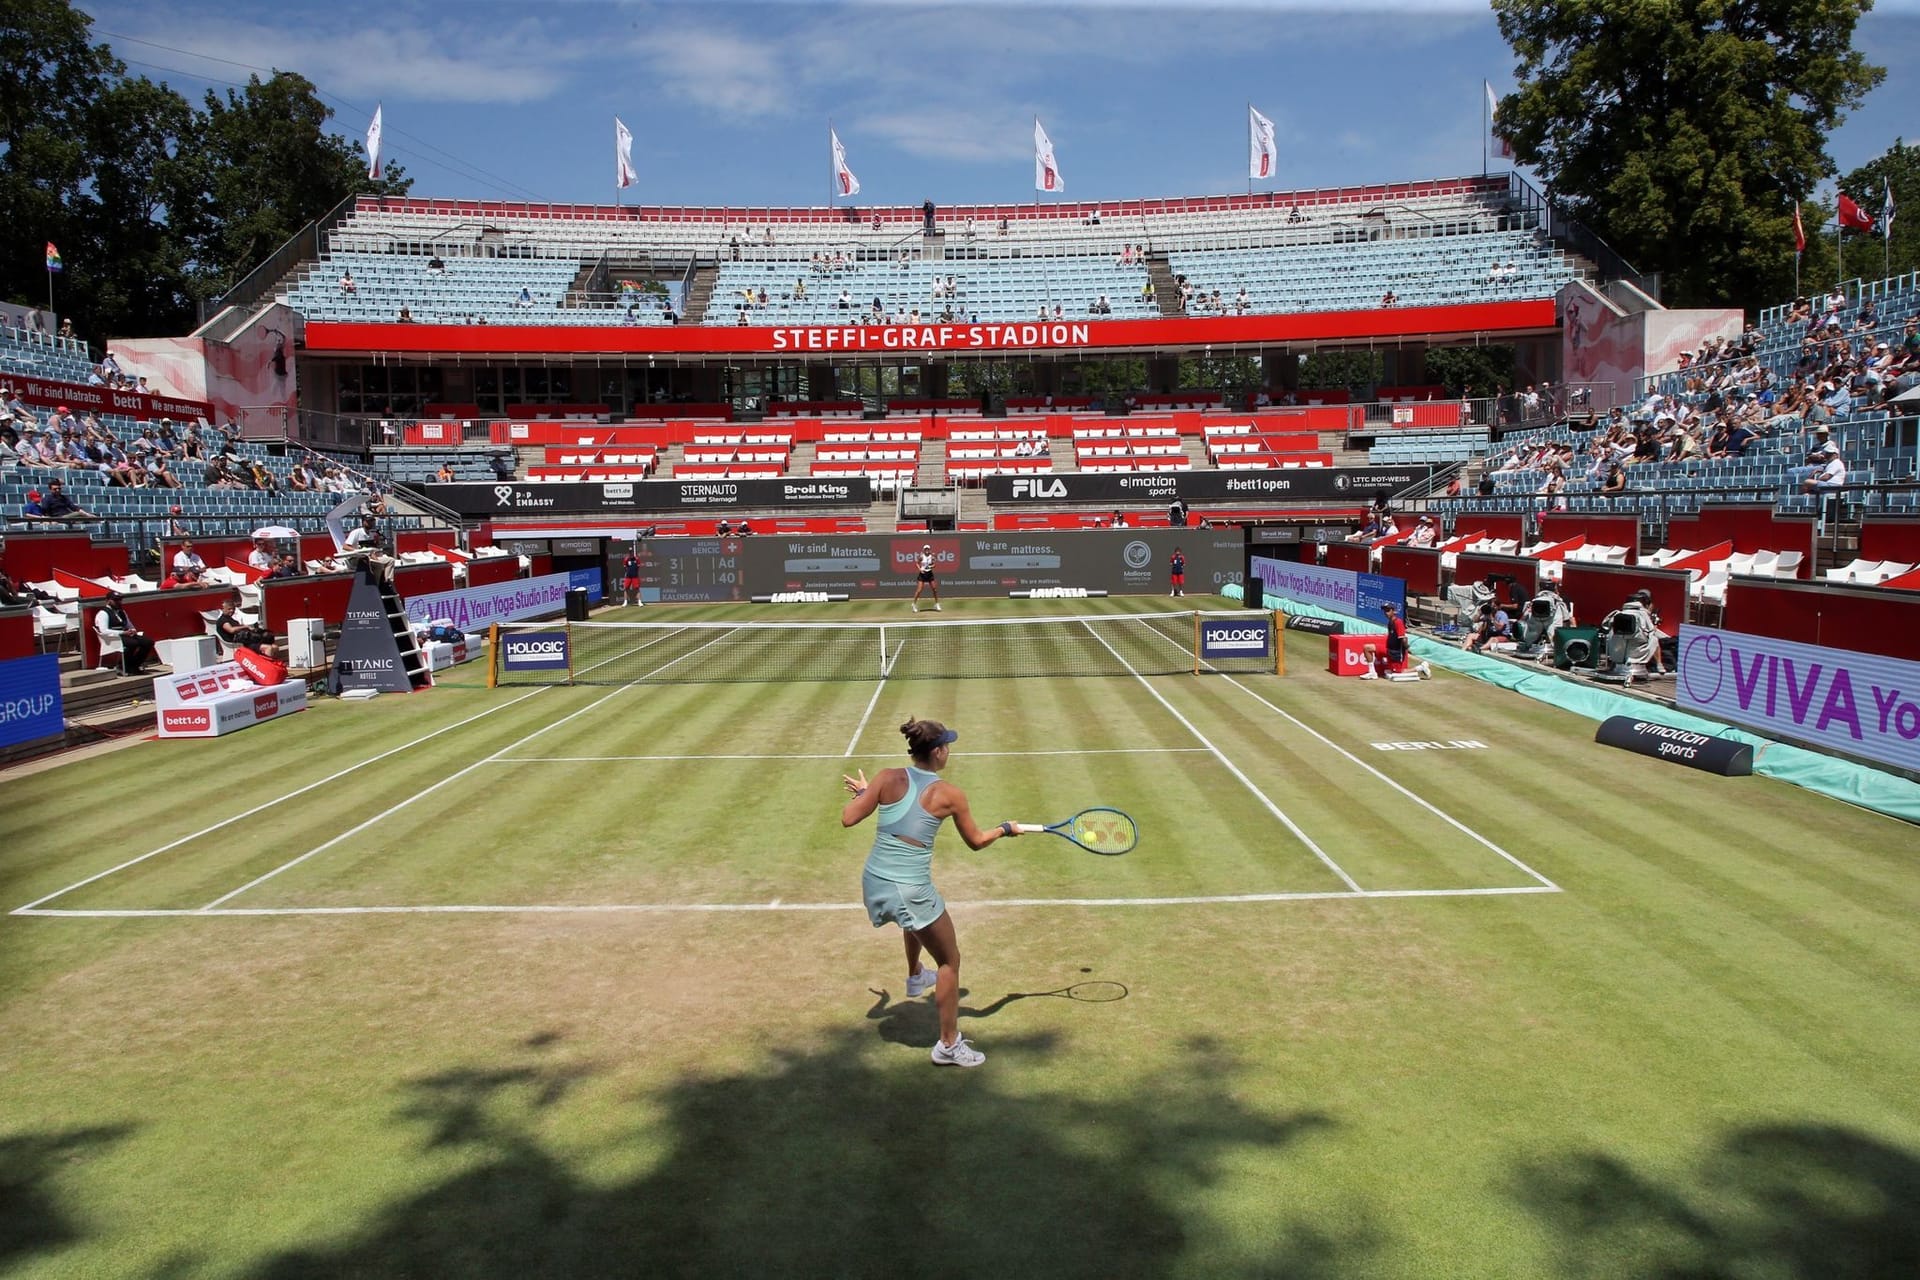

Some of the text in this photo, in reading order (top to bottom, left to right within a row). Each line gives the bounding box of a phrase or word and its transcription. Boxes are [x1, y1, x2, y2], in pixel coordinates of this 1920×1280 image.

[772, 324, 1090, 349] STEFFI-GRAF-STADION
[27, 382, 104, 405] Wir sind Matratze.
[113, 393, 142, 410] bett1
[151, 399, 206, 417] We are mattress.
[1226, 478, 1290, 491] #bett1open
[1370, 475, 1411, 483] ROT-WEISS
[681, 484, 738, 496] STERNAUTO
[784, 484, 816, 494] Broil
[1012, 478, 1068, 498] FILA
[1148, 487, 1177, 497] sports
[516, 498, 554, 507] EMBASSY
[788, 543, 876, 558] Wir sind Matratze.
[976, 541, 1054, 554] We are mattress.
[670, 557, 735, 569] 3 Ad
[671, 573, 735, 585] 3 40
[1213, 571, 1244, 584] 0:30
[1257, 562, 1278, 591] VIVA
[1277, 570, 1290, 587] Your
[1289, 572, 1304, 595] Yoga
[1304, 576, 1326, 598] Studio
[1325, 580, 1333, 599] in
[1333, 583, 1355, 605] Berlin
[663, 593, 710, 601] KALINSKAYA
[427, 597, 470, 628] VIVA
[470, 599, 491, 618] Your
[492, 595, 514, 617] Yoga
[515, 587, 541, 609] Studio
[541, 587, 550, 603] in
[347, 611, 380, 619] TITANIC
[1206, 629, 1265, 641] HOLOGIC
[507, 641, 564, 654] HOLOGIC
[242, 658, 266, 680] Wilson
[341, 658, 394, 670] TITANIC
[359, 672, 377, 680] HOTELS
[1730, 648, 1864, 741] VIVA
[0, 694, 54, 724] GROUP
[255, 700, 277, 712] bett1.de
[166, 716, 207, 726] bett1.de
[1370, 741, 1489, 752] BERLIN
[1657, 741, 1699, 759] sports
